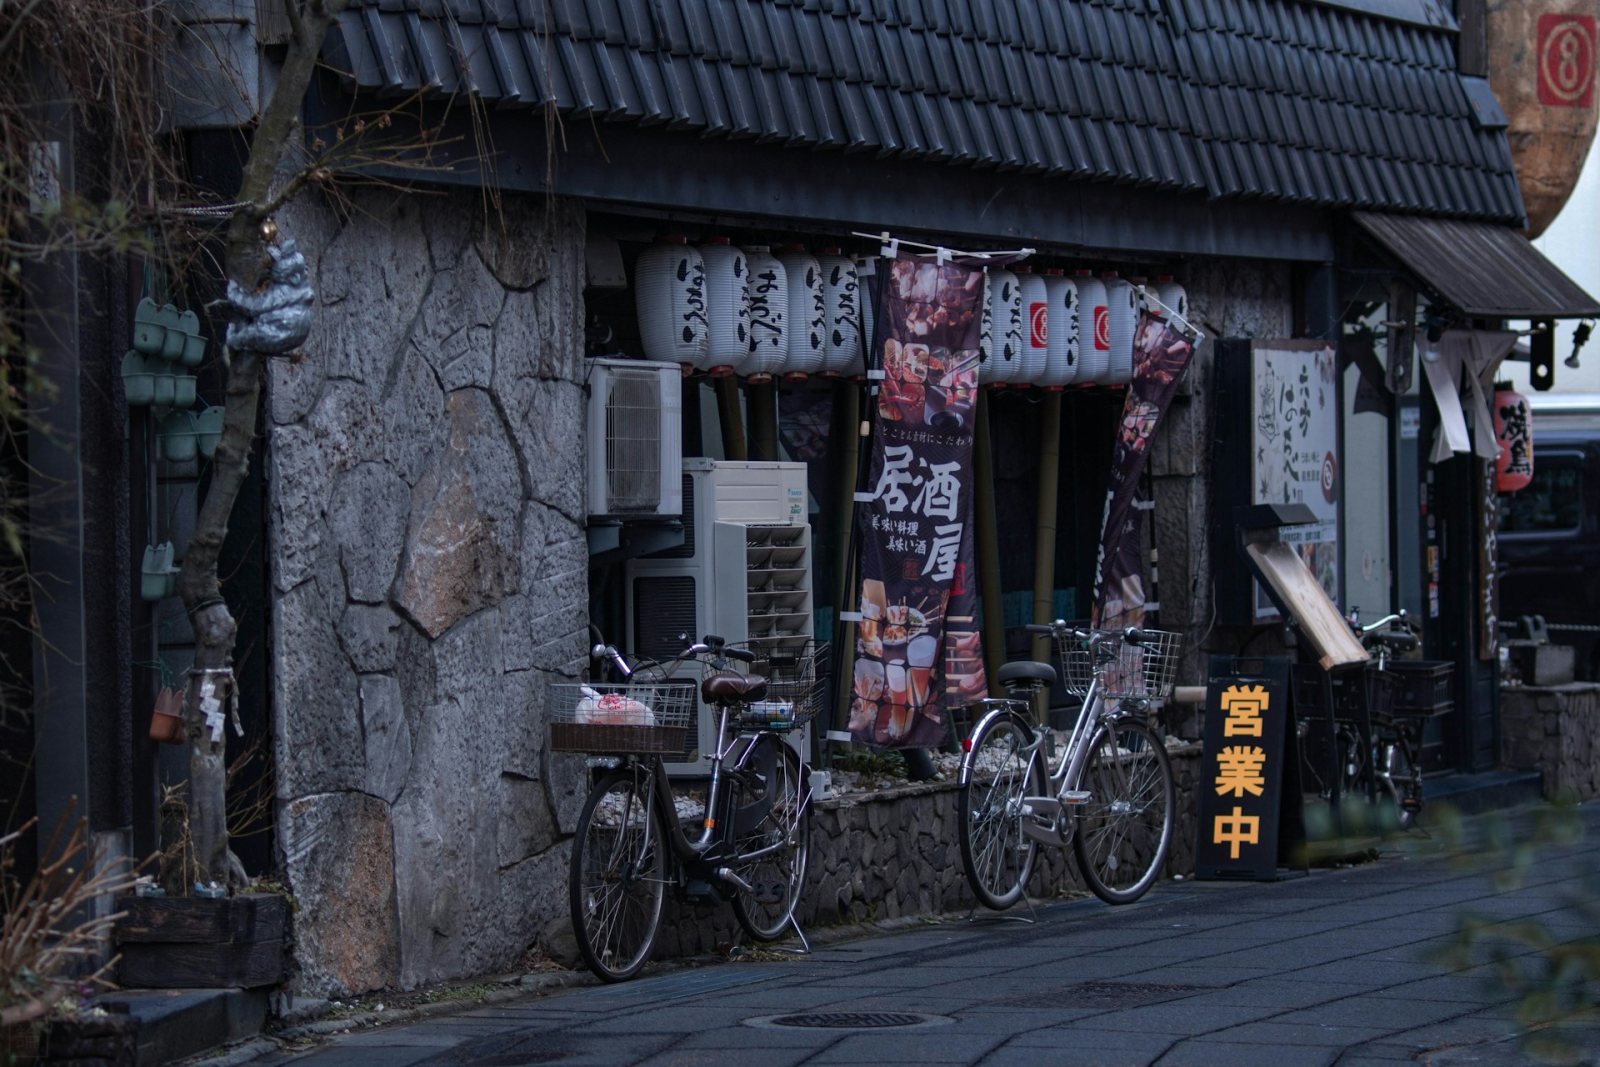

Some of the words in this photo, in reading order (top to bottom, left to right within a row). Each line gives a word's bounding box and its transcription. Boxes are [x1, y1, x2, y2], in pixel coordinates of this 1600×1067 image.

[1500, 401, 1531, 475] 焼鳥
[872, 514, 919, 537] 美味い料理
[886, 536, 927, 555] 美味い酒
[1213, 685, 1270, 860] 営業中
